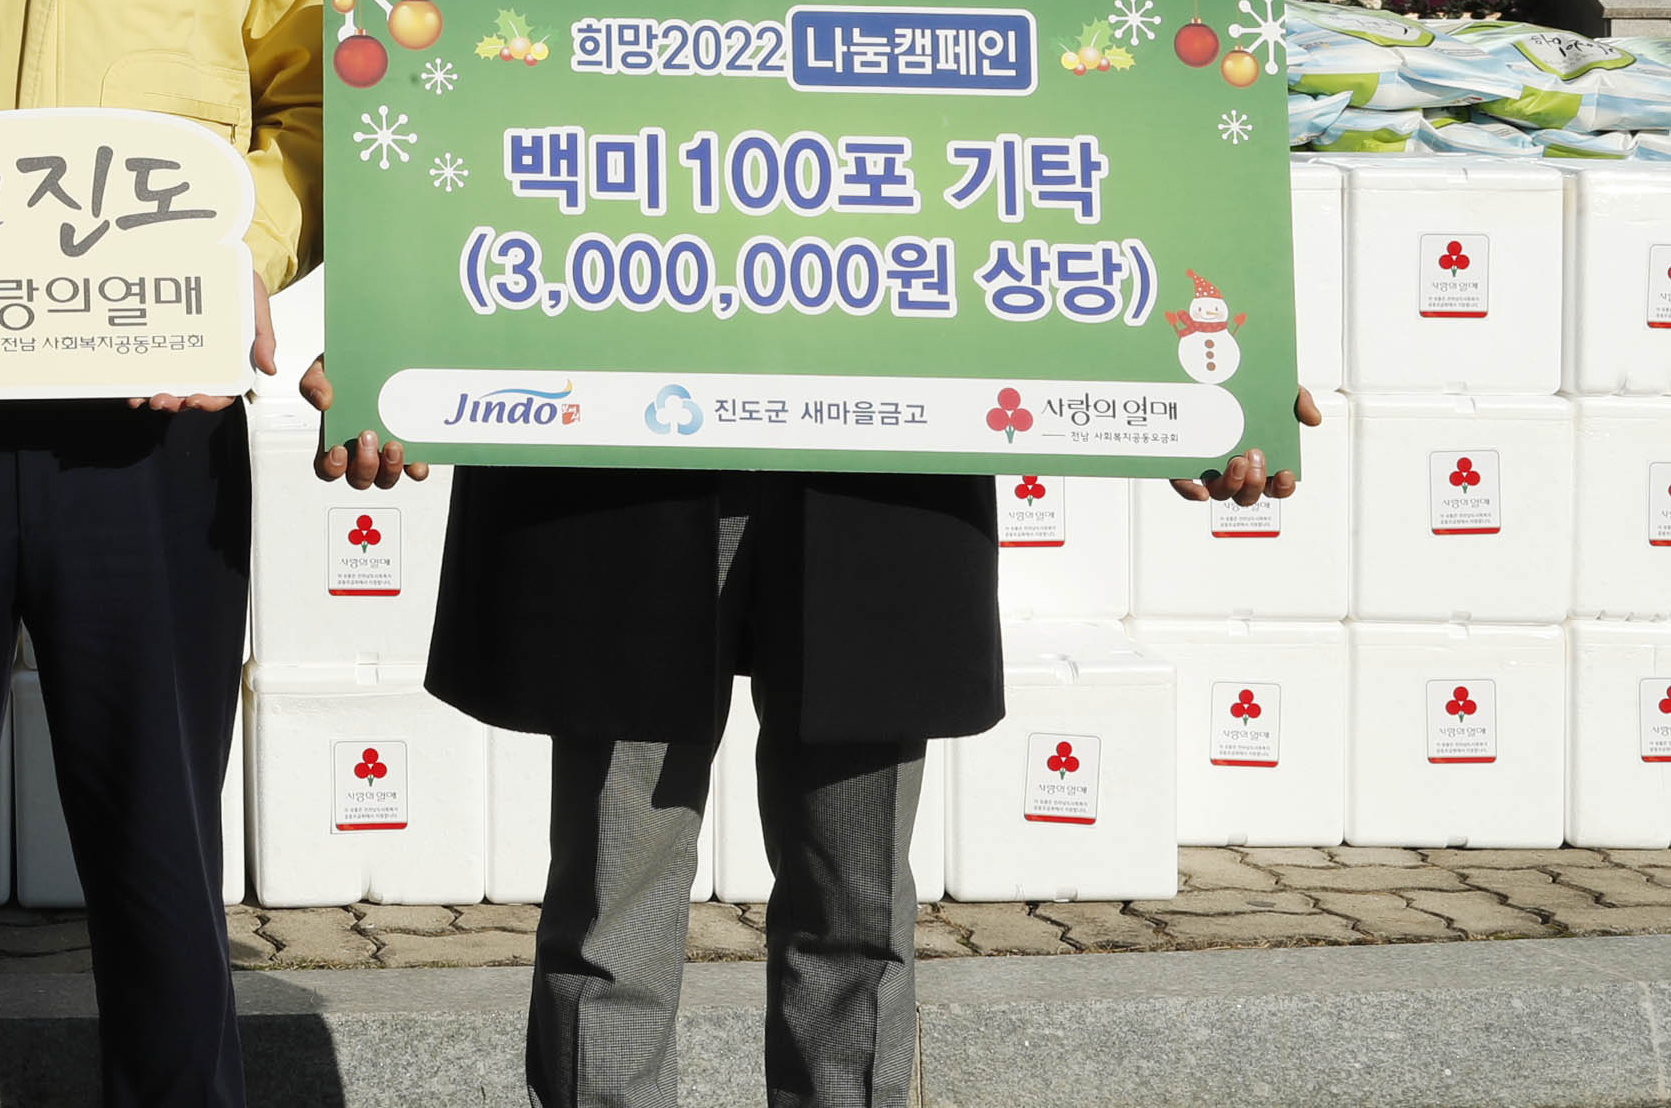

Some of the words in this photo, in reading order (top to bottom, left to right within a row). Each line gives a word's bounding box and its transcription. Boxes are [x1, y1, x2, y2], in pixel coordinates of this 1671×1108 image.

[572, 18, 786, 76] 희망2022
[805, 23, 1018, 80] 나눔캠페인
[16, 145, 218, 259] 진도
[947, 137, 1103, 219] 기탁
[465, 229, 951, 315] (3,000,000원
[981, 242, 1154, 323] 상당)
[1, 335, 37, 354] 전남
[41, 333, 205, 355] 사회복지공동모금회
[444, 393, 557, 425] Jindo
[714, 398, 789, 425] 진도군
[801, 399, 928, 426] 새마을금고
